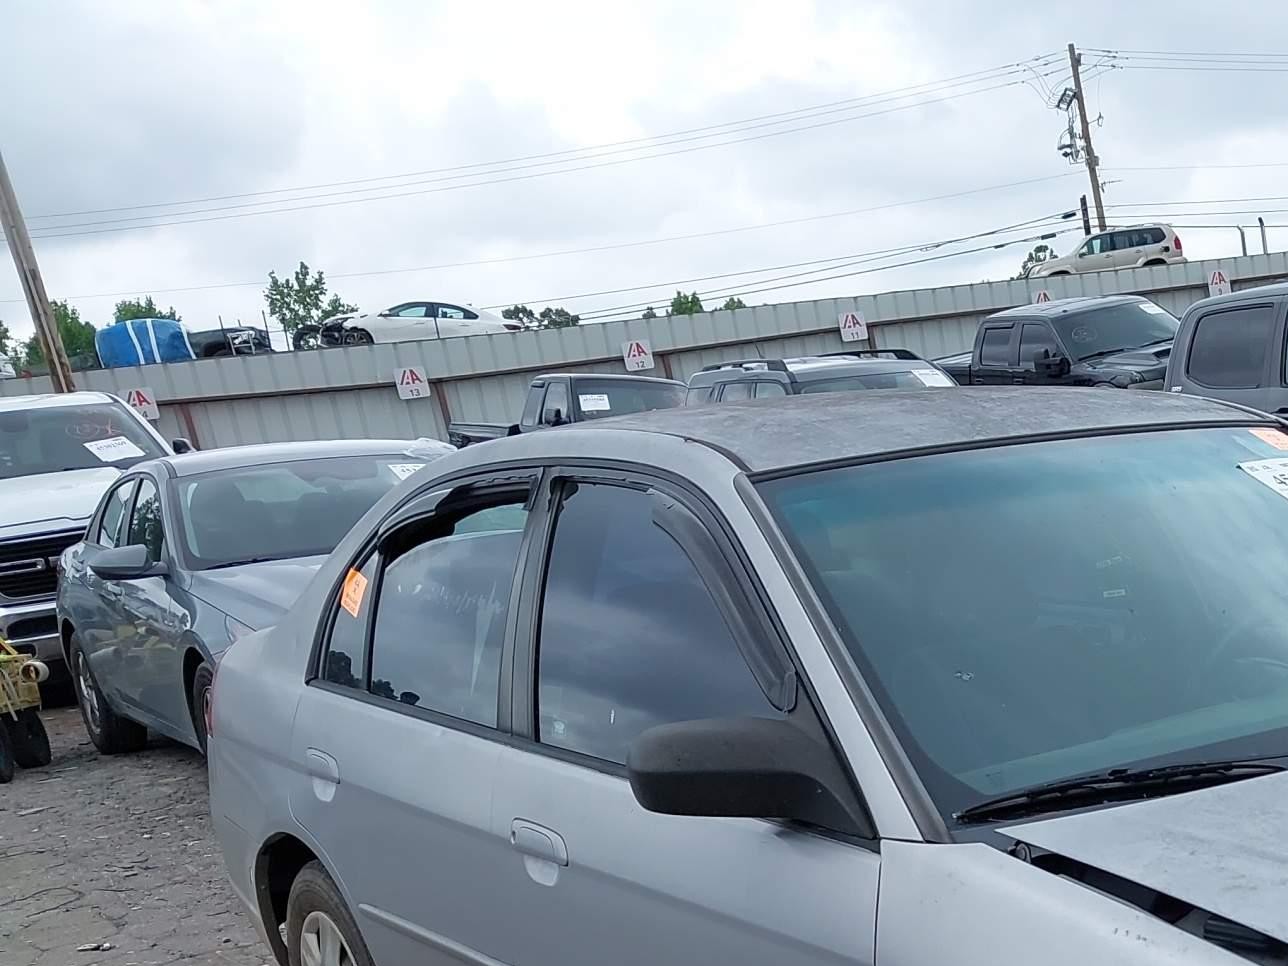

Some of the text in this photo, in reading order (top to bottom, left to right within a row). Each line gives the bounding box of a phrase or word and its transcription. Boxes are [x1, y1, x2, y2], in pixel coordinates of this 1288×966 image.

[635, 360, 646, 369] 12
[409, 388, 421, 397] 13
[141, 410, 149, 419] 4
